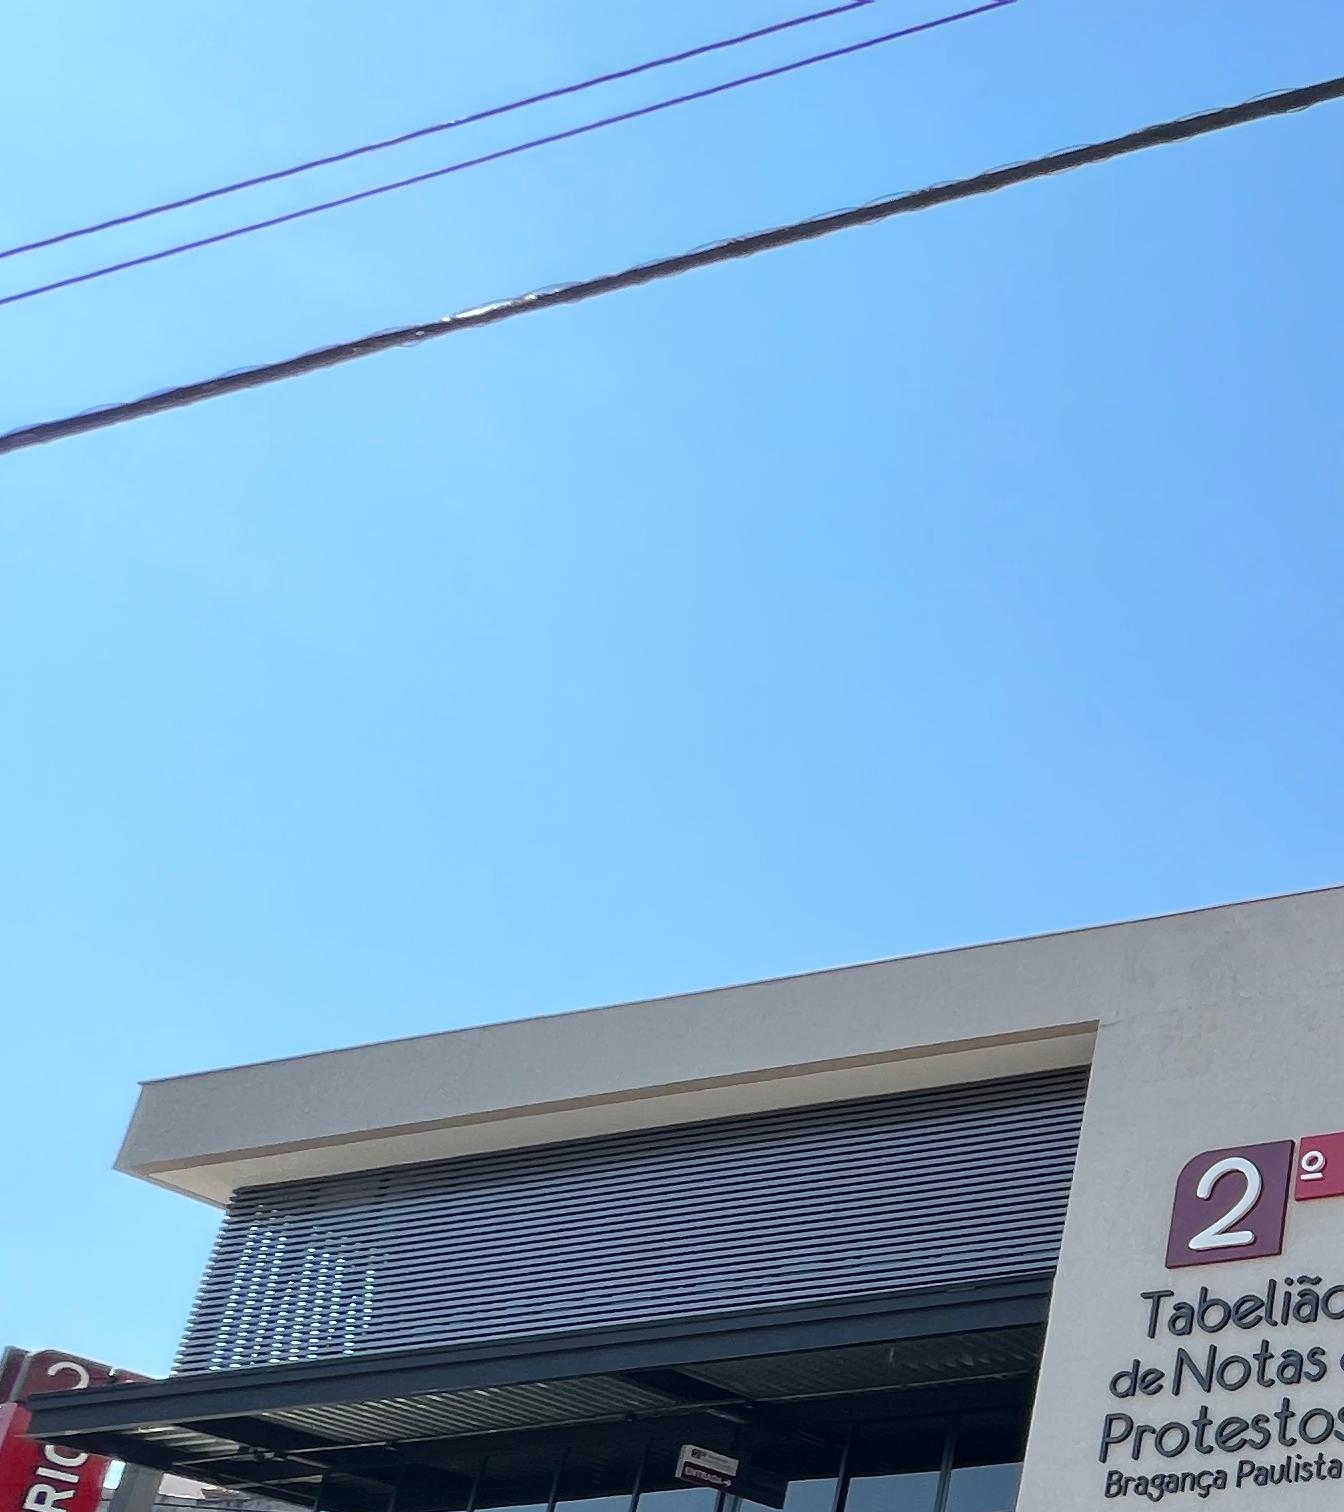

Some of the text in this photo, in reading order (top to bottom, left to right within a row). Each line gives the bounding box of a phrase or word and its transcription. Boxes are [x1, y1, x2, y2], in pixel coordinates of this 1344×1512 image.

[1109, 1359, 1164, 1399] de
[1172, 1340, 1327, 1397] Notas
[1104, 1453, 1344, 1502] Bragança Paulista
